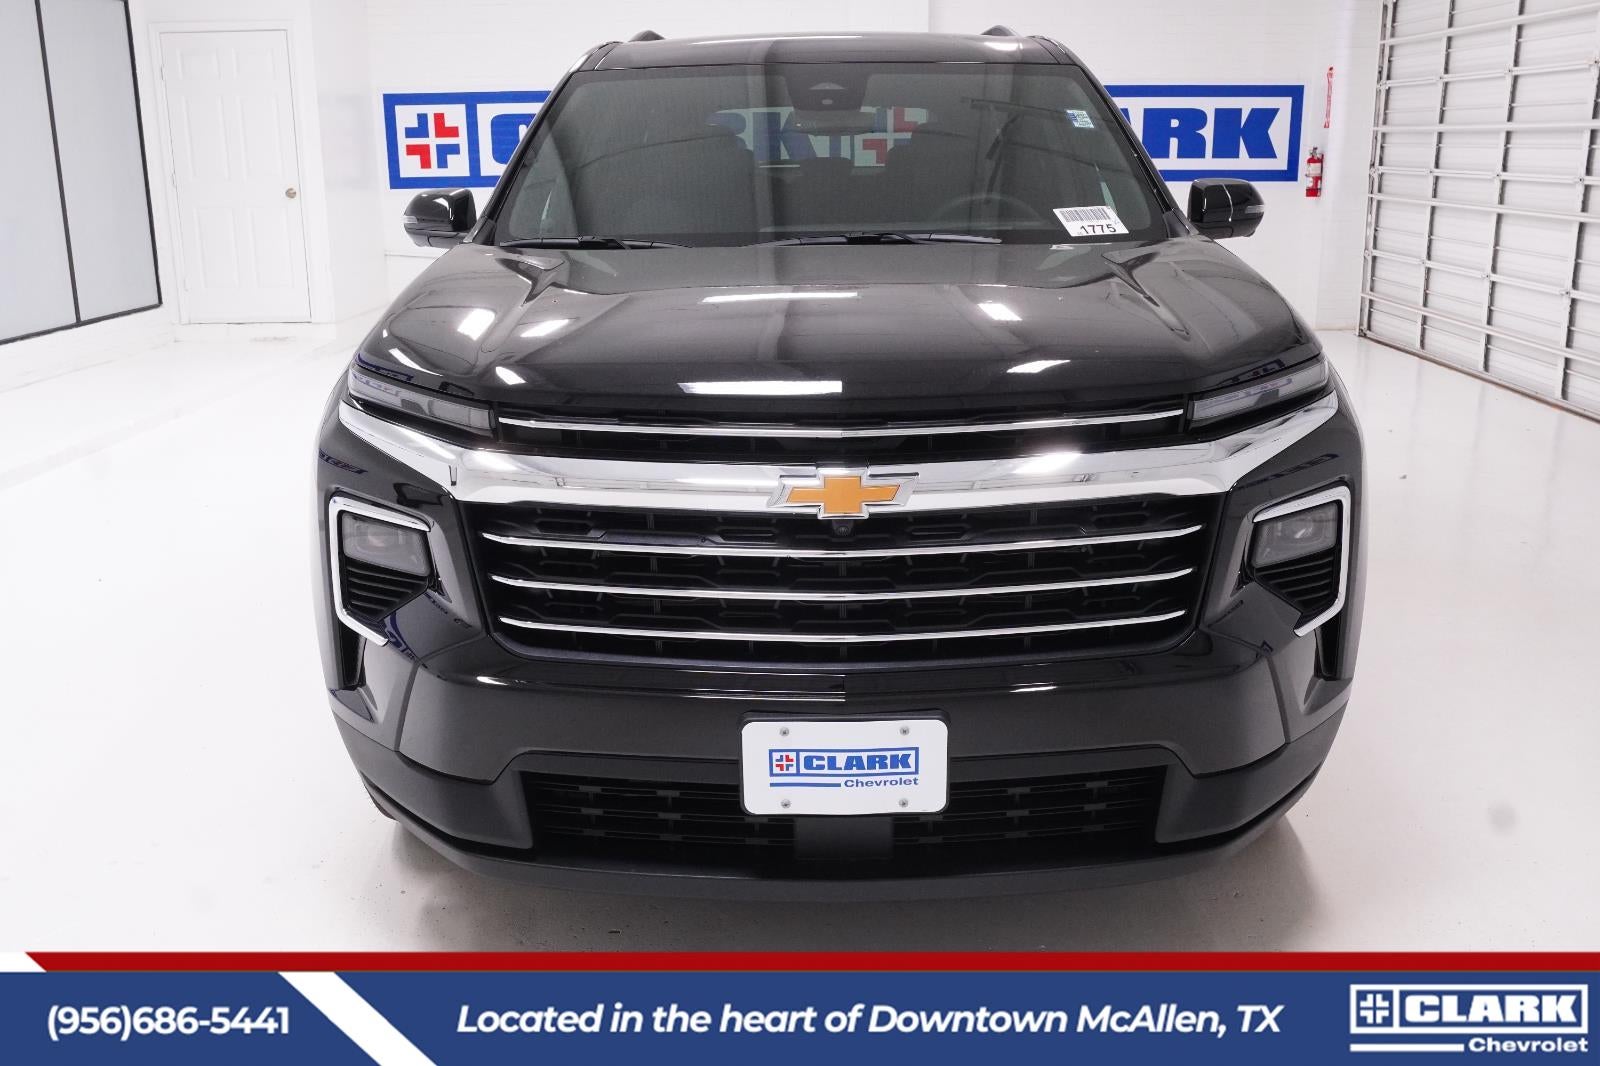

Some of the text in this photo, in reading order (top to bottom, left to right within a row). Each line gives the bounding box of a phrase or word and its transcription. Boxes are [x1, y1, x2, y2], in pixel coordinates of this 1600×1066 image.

[1080, 223, 1117, 234] 1775
[803, 753, 912, 771] CLARK
[843, 777, 919, 788] Chevrolet
